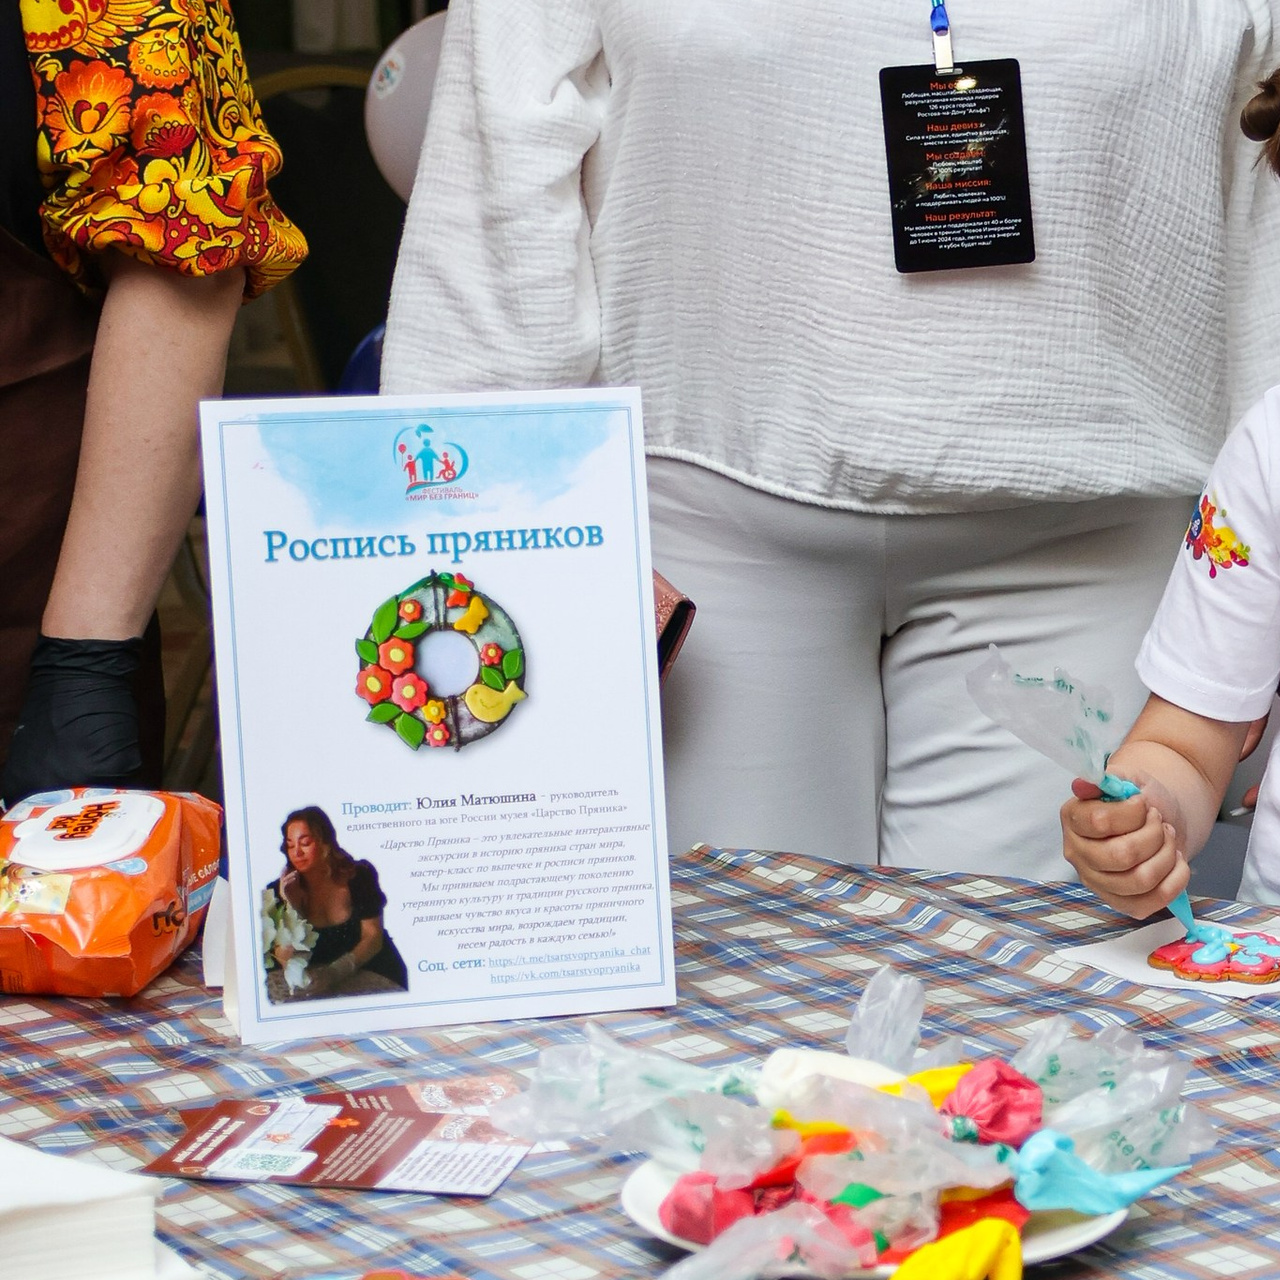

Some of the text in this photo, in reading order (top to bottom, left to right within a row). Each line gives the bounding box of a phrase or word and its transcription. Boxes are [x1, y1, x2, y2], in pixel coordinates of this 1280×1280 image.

[930, 82, 946, 90] Мы
[927, 124, 949, 132] Наш
[925, 179, 992, 190] Наша миссия:
[925, 210, 997, 222] Наш результат:
[444, 492, 479, 500] ГРАНИЦ»
[263, 525, 605, 563] Роспись пряников
[341, 801, 412, 818] Проводит:
[416, 797, 457, 810] Юлия
[460, 792, 537, 807] Матюшина
[550, 788, 619, 803] руководитель
[51, 815, 78, 831] Kid
[59, 801, 118, 841] Honey
[346, 804, 627, 832] единственного на юге России музея «Царство Пряника»
[380, 839, 425, 851] «Царство
[427, 836, 471, 849] Пряника
[481, 834, 498, 843] это
[499, 829, 573, 844] увлекательные
[575, 823, 651, 836] интерактивные
[417, 852, 470, 864] экскурсии
[480, 848, 523, 861] историю
[525, 844, 566, 856] пряника
[569, 842, 596, 853] стран
[599, 840, 625, 851] мира,
[410, 866, 473, 879] мастер-класс
[476, 866, 489, 874] по
[491, 861, 533, 872] выпечке
[543, 858, 585, 870] росписи
[587, 854, 636, 867] пряников.
[421, 869, 634, 893] Мы прививаем подрастающему поколению
[401, 898, 457, 911] утерянную
[459, 893, 506, 905] культуру
[516, 889, 563, 902] традиции
[565, 886, 609, 898] русского
[611, 882, 655, 894] пряника,
[412, 913, 462, 926] развиваем
[465, 909, 503, 920] чувство
[505, 906, 531, 918] вкуса
[543, 903, 583, 915] красоты
[585, 898, 645, 912] пряничного
[437, 914, 627, 938] искусства мира, возрождаем традиции,
[457, 941, 486, 950] несем
[488, 937, 527, 950] радость
[537, 933, 576, 945] каждую
[577, 928, 617, 940] семью!»
[418, 958, 486, 972] Соц. сети:
[490, 962, 641, 984] https://vk.com/tsarstvopryanika
